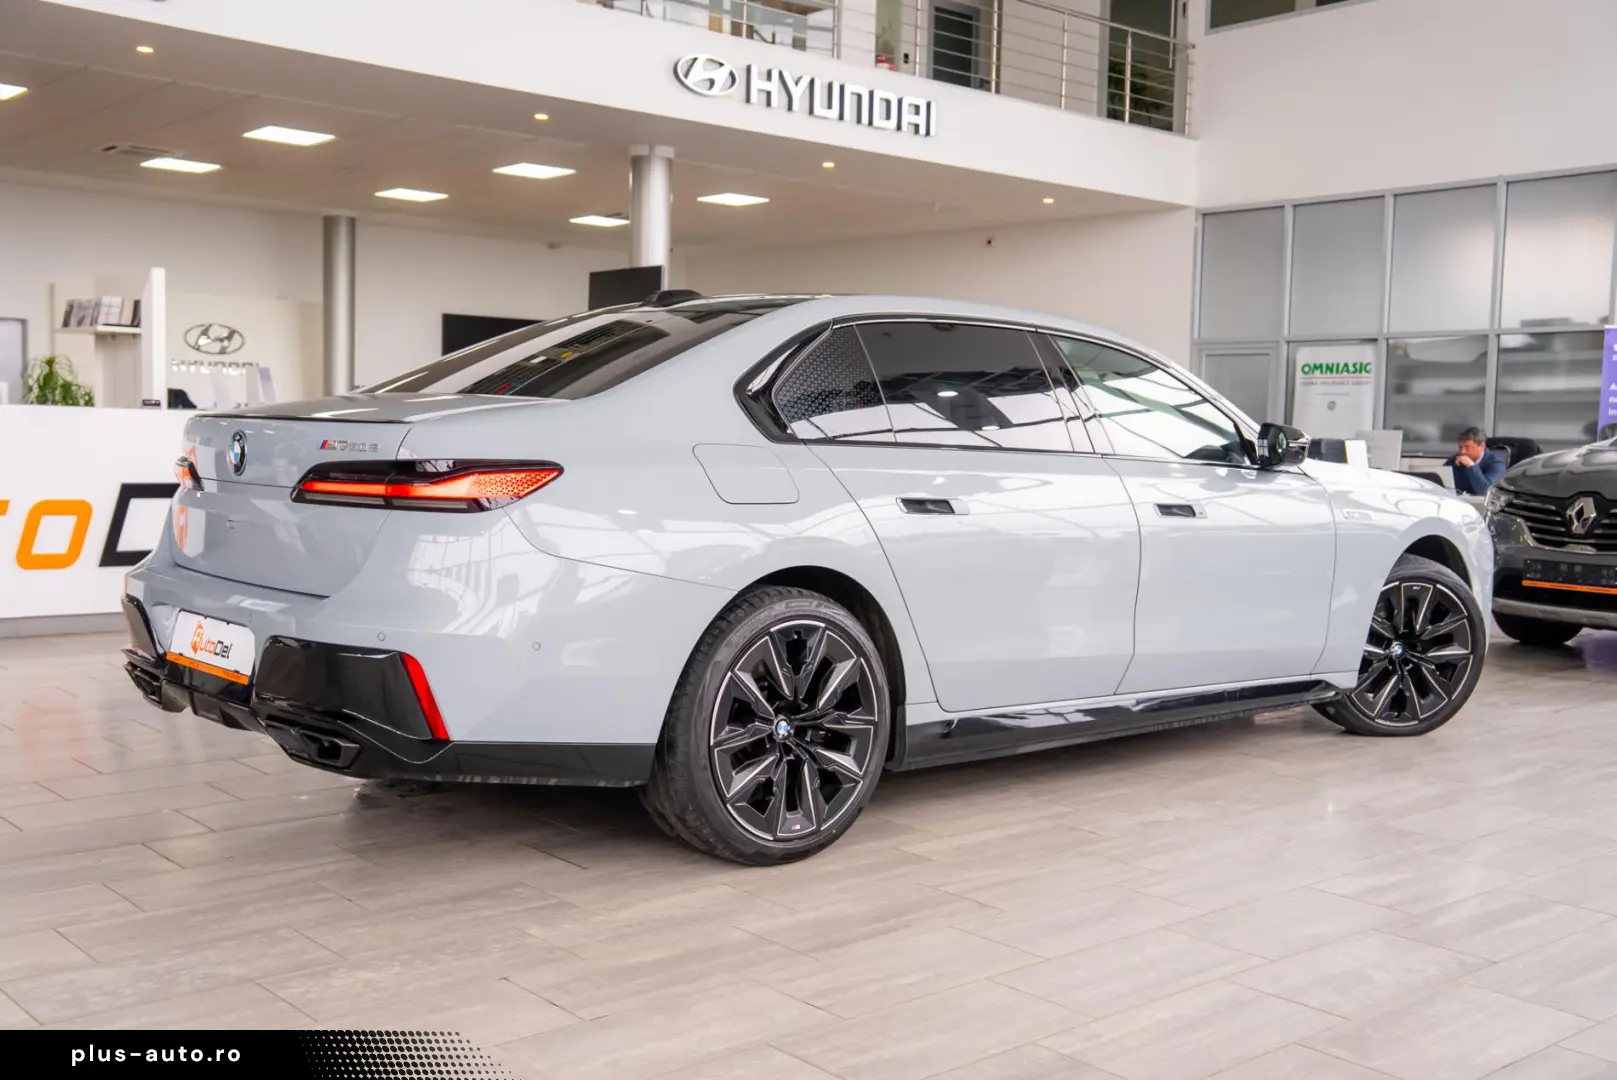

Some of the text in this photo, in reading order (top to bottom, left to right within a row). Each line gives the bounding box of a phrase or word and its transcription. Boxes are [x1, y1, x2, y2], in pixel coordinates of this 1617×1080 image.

[746, 63, 937, 137] HYUNDAI
[171, 359, 260, 376] HYUNDA
[1301, 362, 1372, 375] OMNIASIG
